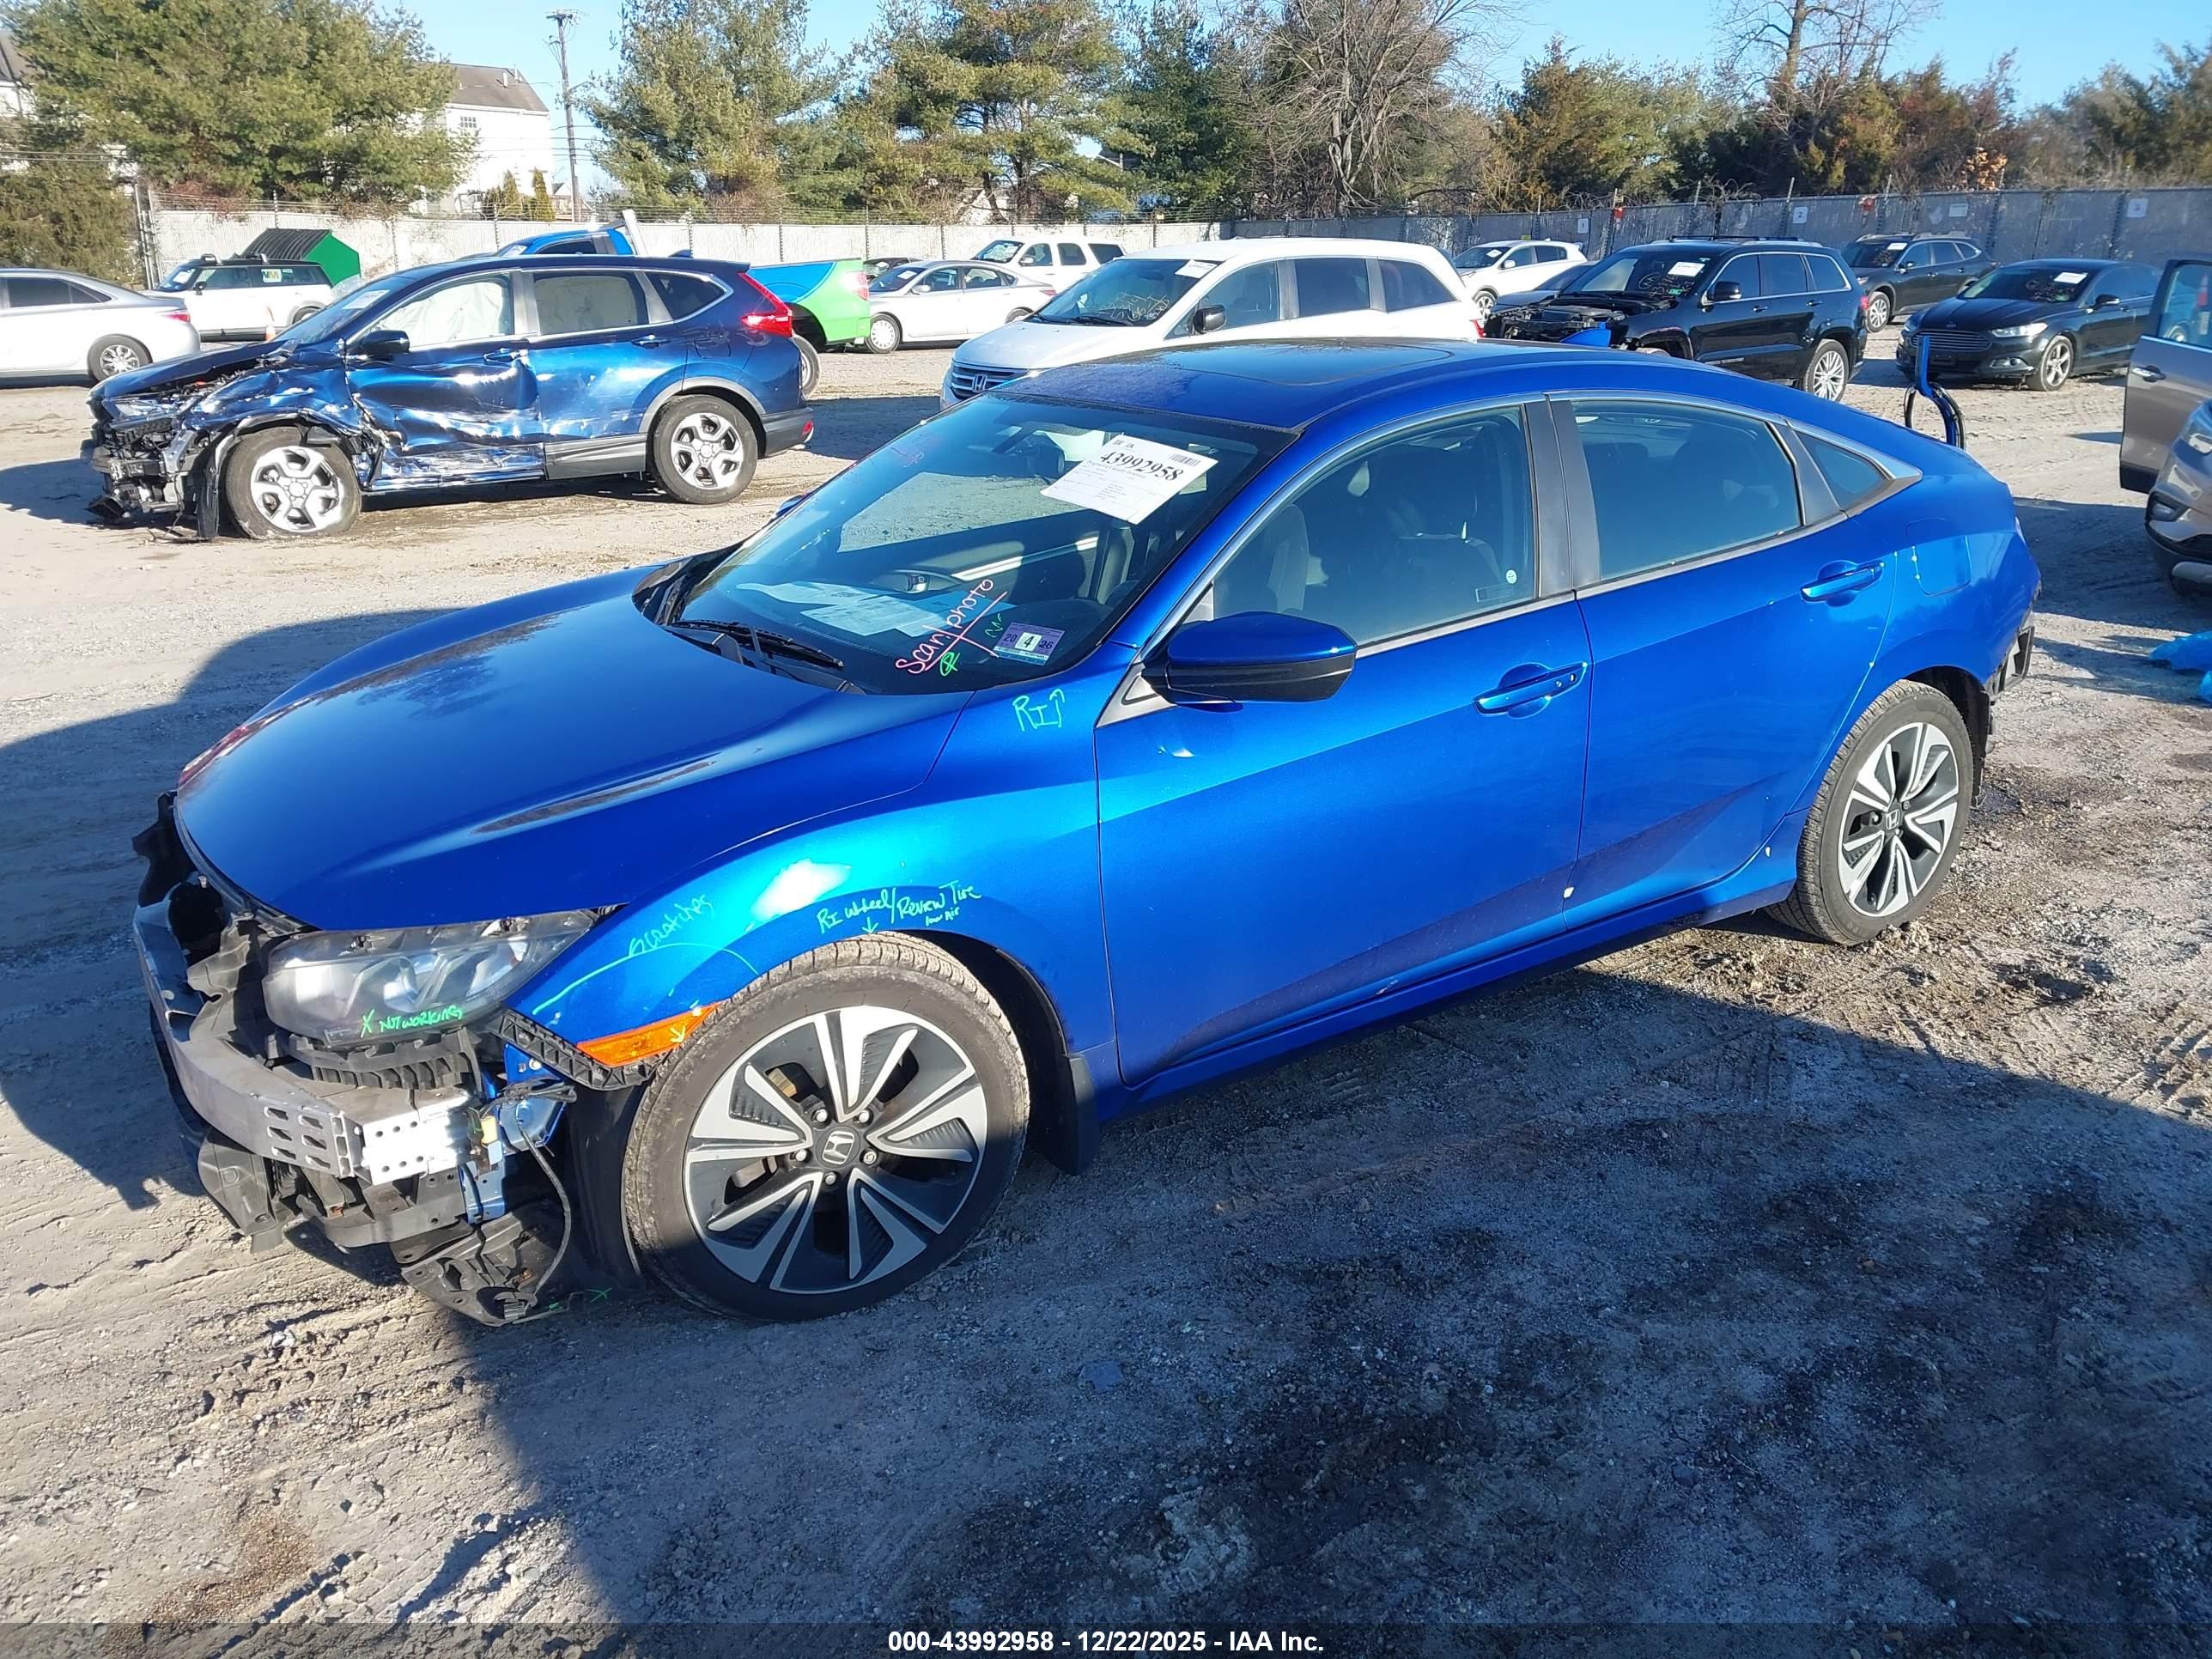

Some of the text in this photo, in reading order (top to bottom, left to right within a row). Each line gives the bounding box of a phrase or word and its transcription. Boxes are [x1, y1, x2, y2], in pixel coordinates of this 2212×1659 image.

[1100, 451, 1184, 482] 43992958
[1003, 633, 1054, 650] 20 4 26
